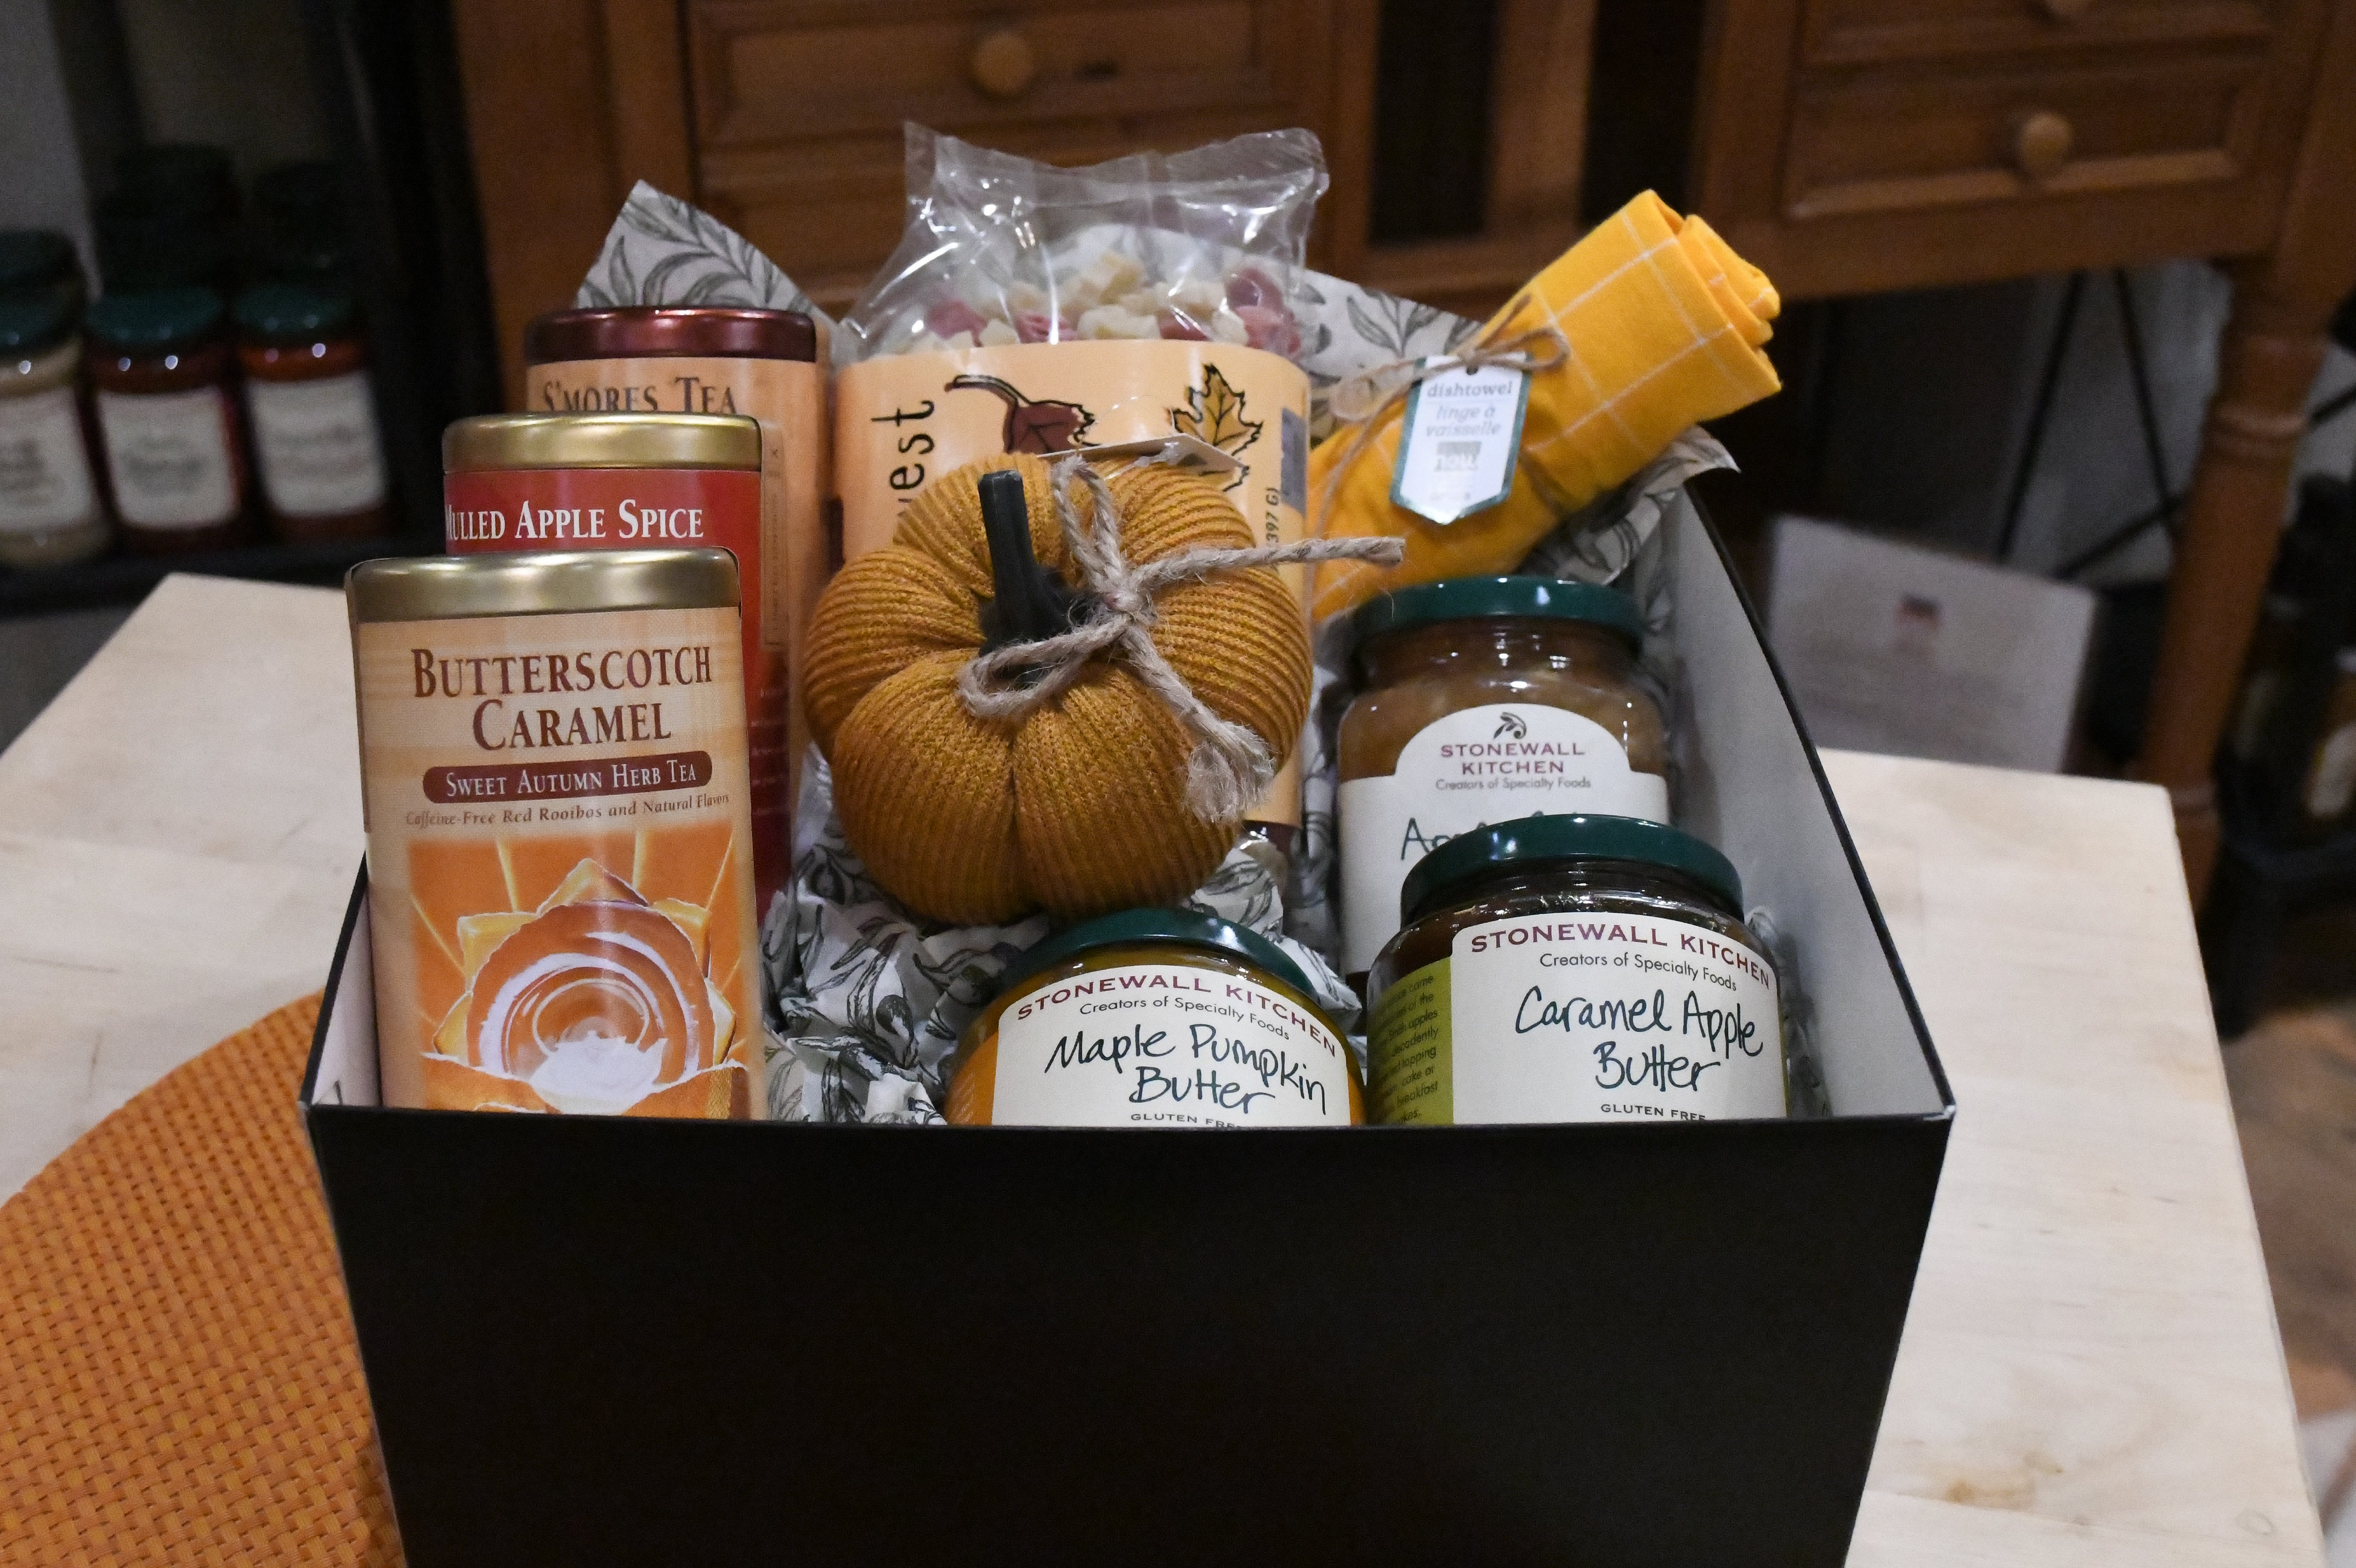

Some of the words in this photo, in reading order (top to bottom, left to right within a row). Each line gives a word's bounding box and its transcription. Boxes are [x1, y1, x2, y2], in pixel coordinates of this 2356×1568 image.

[675, 377, 738, 414] TEA
[1427, 380, 1513, 397] dishtowel
[515, 500, 606, 539] APPLE
[618, 499, 704, 539] SPICE
[411, 646, 712, 698] BUTTERSCOTCH
[473, 698, 671, 751] CARAMEL
[1441, 742, 1585, 758] STONEWALL
[1462, 760, 1564, 775] KITCHEN
[446, 772, 506, 798] SWEET
[518, 769, 602, 794] AUTUMN
[612, 763, 662, 788] HERB
[666, 760, 697, 783] TEA
[1487, 777, 1499, 789] of
[405, 809, 495, 828] Caffeine-Free
[503, 808, 532, 822] Red
[539, 804, 602, 821] Rooibos
[609, 801, 636, 816] and
[643, 795, 692, 813] Natural
[697, 793, 729, 808] Flavors
[1471, 923, 1668, 953] STONEWALL
[1680, 933, 1770, 990] KITCHEN
[1540, 953, 1608, 969] Creators
[1614, 952, 1629, 966] of
[1634, 954, 1699, 982] Specialty
[1703, 967, 1737, 991] Foods
[1018, 975, 1211, 1021] STONEWALL
[1225, 984, 1335, 1058] KITCHEN
[1080, 997, 1147, 1015] Creators
[1153, 995, 1170, 1008] of
[1175, 997, 1245, 1023] Specialty
[1250, 1013, 1290, 1041] Foods
[1515, 985, 1672, 1034] Caramel
[1682, 990, 1764, 1058] Apple
[1044, 1024, 1175, 1074] Maple
[1189, 1024, 1327, 1115] Pumpkin
[1594, 1041, 1721, 1092] Butter
[1129, 1066, 1275, 1115] Butter
[1601, 1104, 1664, 1116] GLUTEN
[1131, 1113, 1197, 1123] GLUTEN
